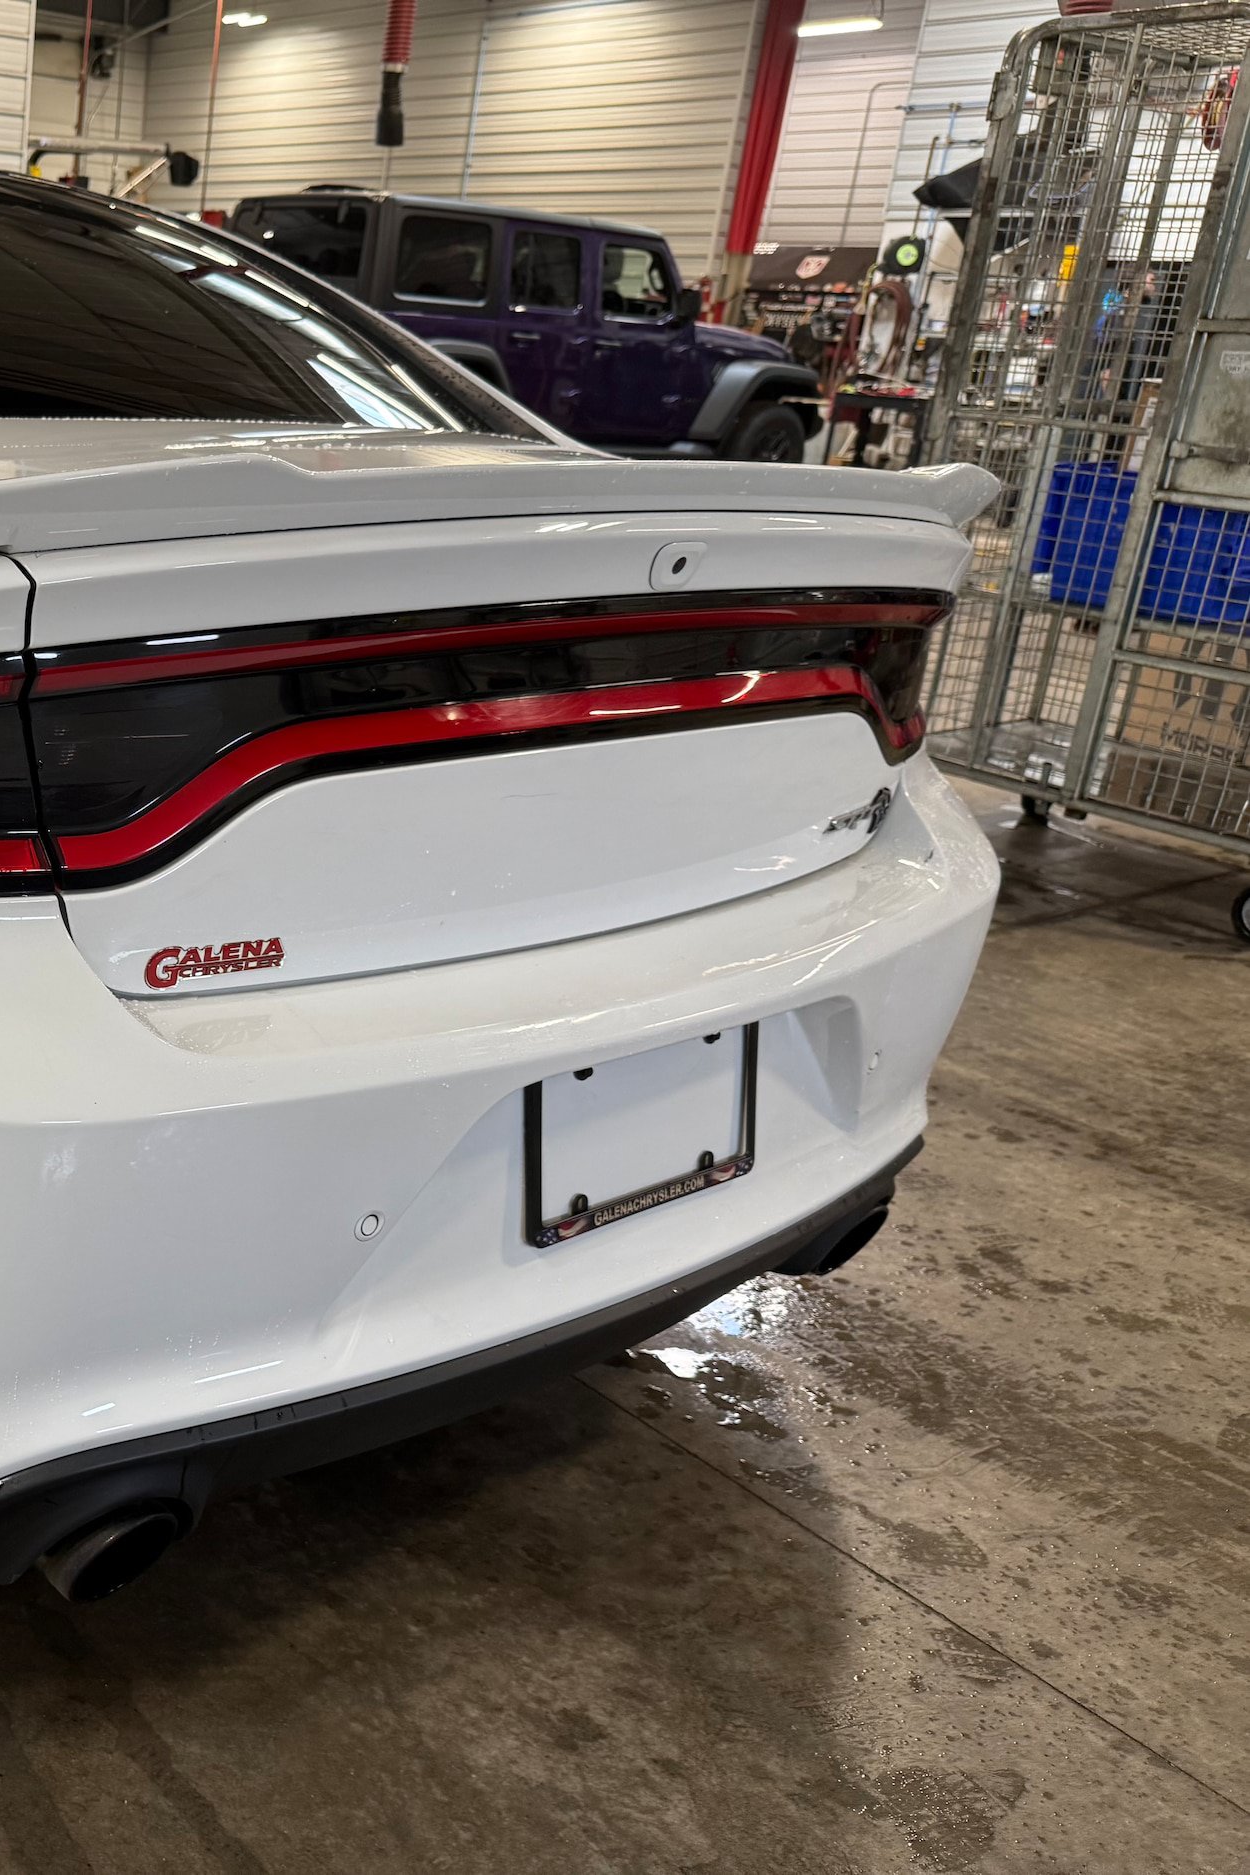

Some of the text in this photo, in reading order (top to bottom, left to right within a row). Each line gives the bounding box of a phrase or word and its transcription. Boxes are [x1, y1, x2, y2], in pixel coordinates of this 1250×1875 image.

[145, 937, 284, 989] GALENA
[179, 959, 281, 976] CHRYSLER
[594, 1176, 704, 1226] GALENACHRYSLER.COM
